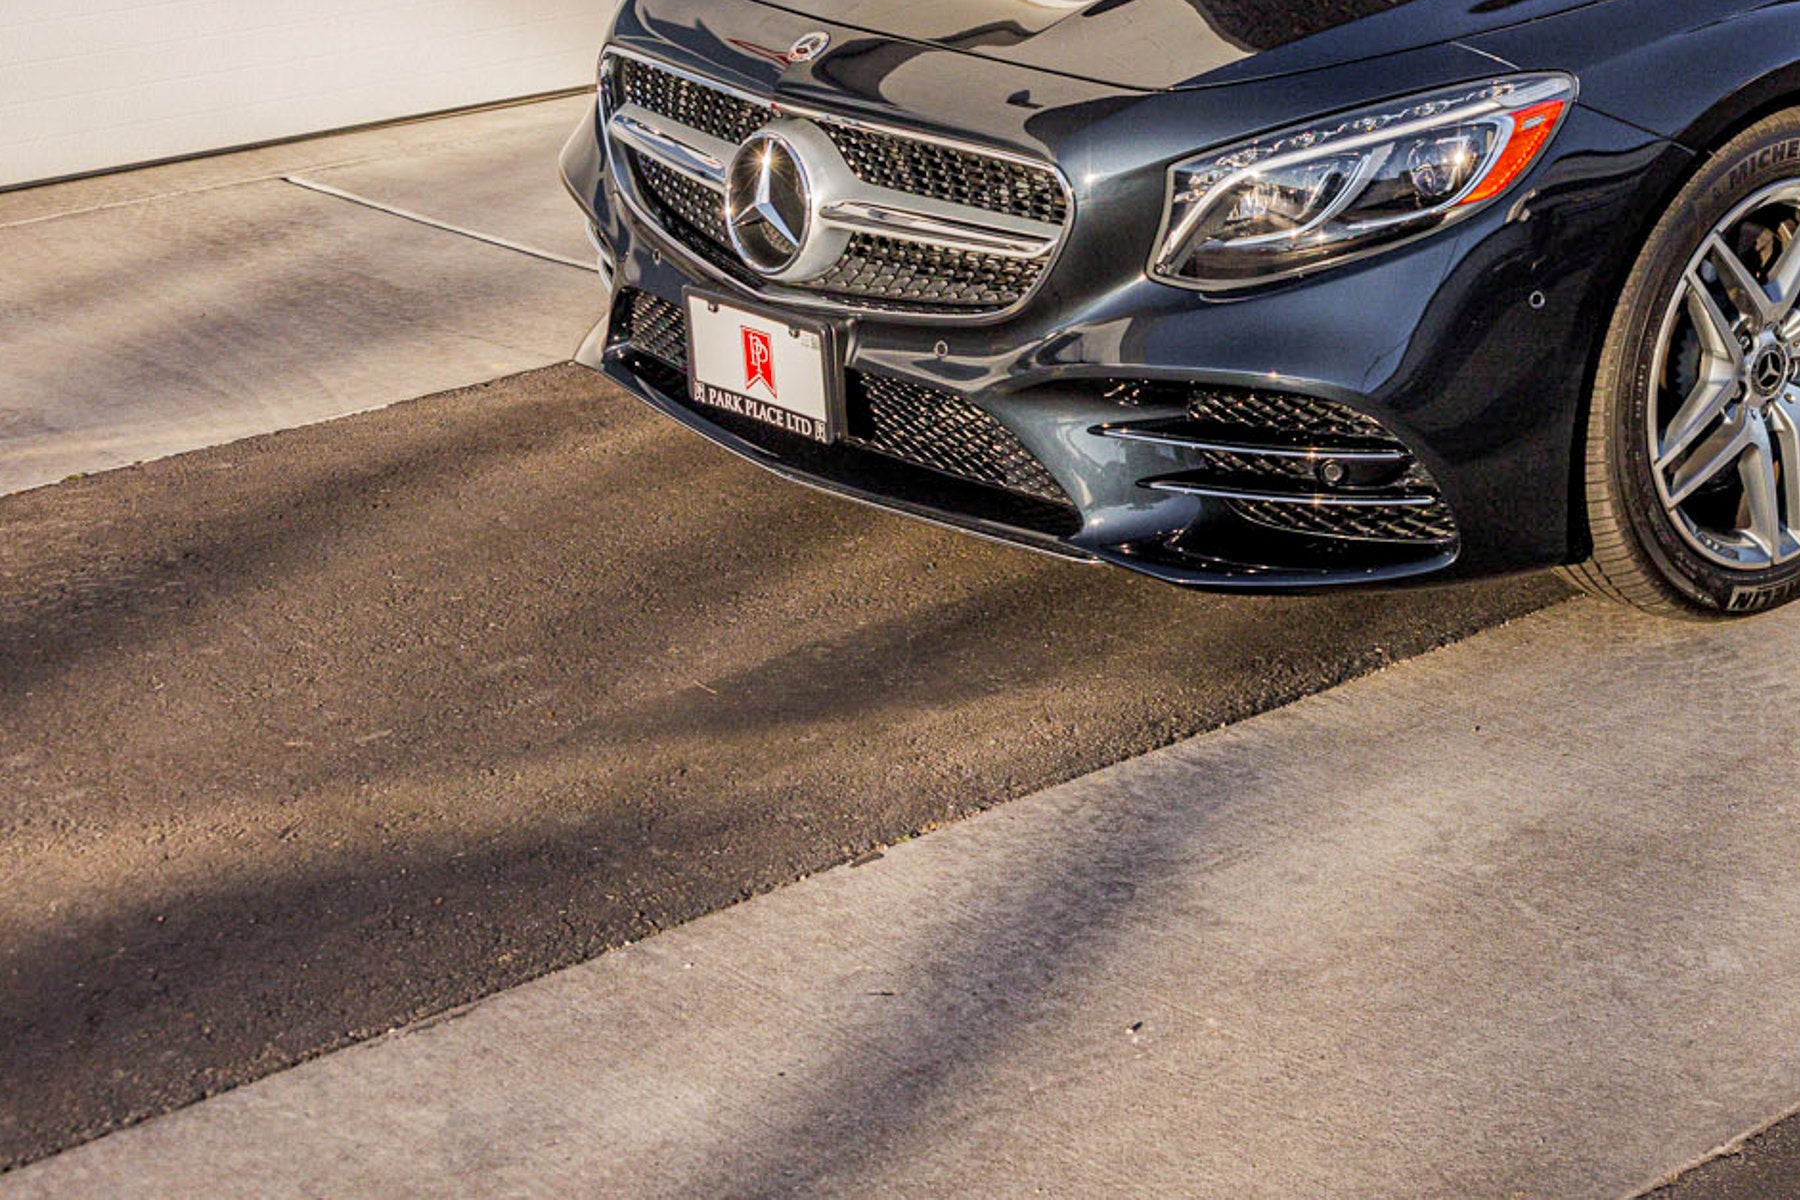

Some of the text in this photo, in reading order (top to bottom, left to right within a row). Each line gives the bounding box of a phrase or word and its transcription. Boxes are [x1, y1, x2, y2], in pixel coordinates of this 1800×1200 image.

[708, 388, 744, 414] PARK
[745, 399, 784, 426] PLACE
[786, 412, 812, 436] LTD
